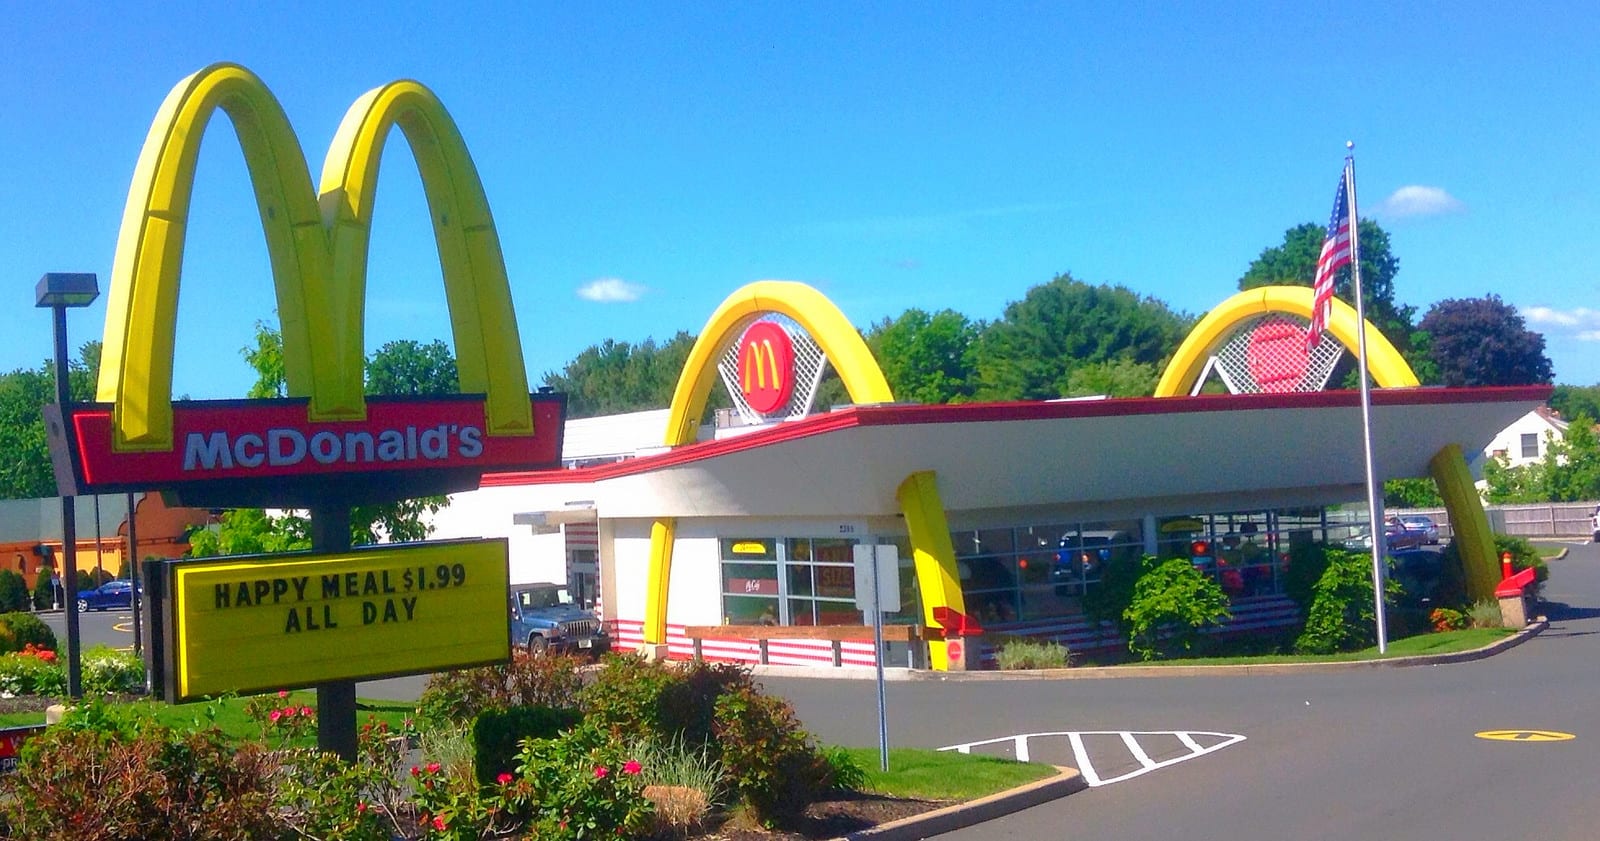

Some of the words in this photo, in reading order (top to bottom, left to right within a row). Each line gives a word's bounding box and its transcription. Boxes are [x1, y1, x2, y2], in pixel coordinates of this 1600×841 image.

[744, 339, 780, 393] M
[183, 425, 484, 471] McDonald's
[215, 576, 310, 608] HAPPY
[321, 570, 396, 599] MEAL
[402, 563, 466, 591] $1.99
[285, 605, 338, 633] ALL
[362, 596, 418, 625] DAY
